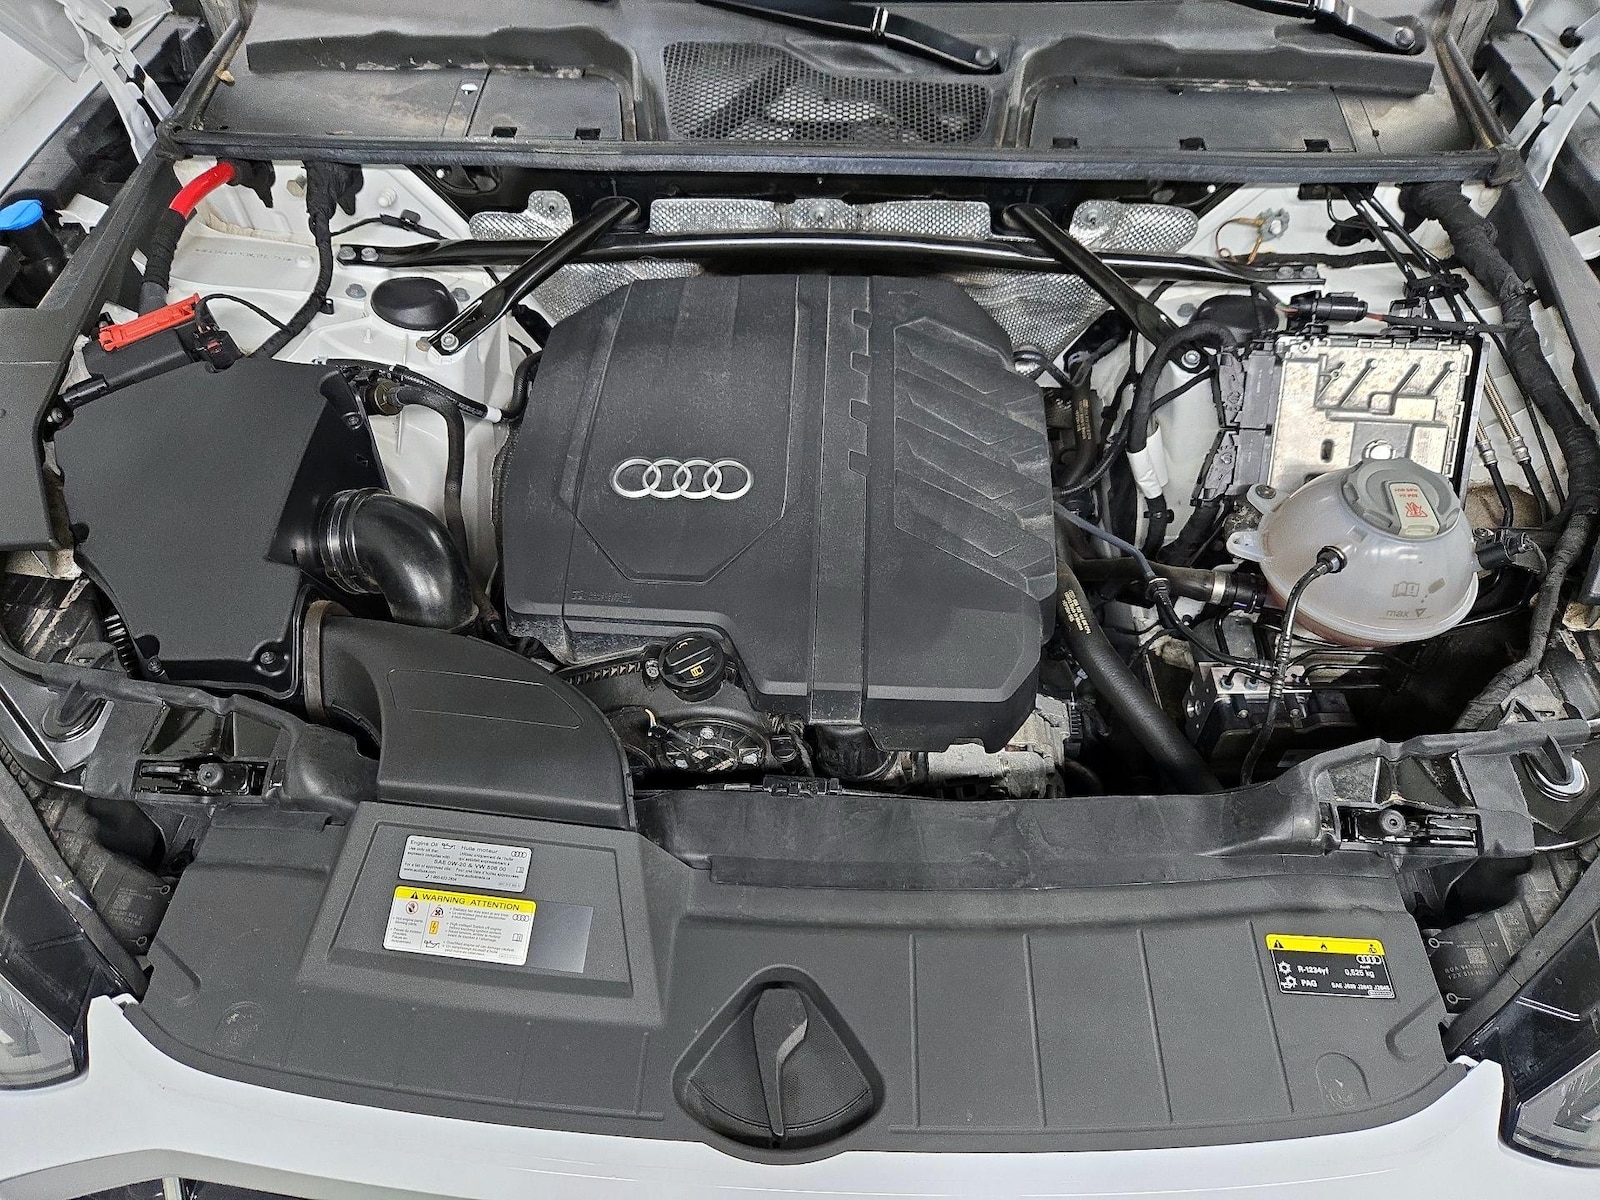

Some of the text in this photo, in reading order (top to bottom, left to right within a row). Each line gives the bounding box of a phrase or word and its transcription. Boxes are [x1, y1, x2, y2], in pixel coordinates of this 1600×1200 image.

[1386, 609, 1409, 618] max
[422, 893, 465, 905] WARNING
[470, 899, 520, 911] ATTENTION
[1297, 965, 1330, 976] R-1234yf
[1344, 968, 1376, 979] 0,525 kg
[1300, 979, 1318, 988] PAG
[1330, 981, 1343, 989] SAE
